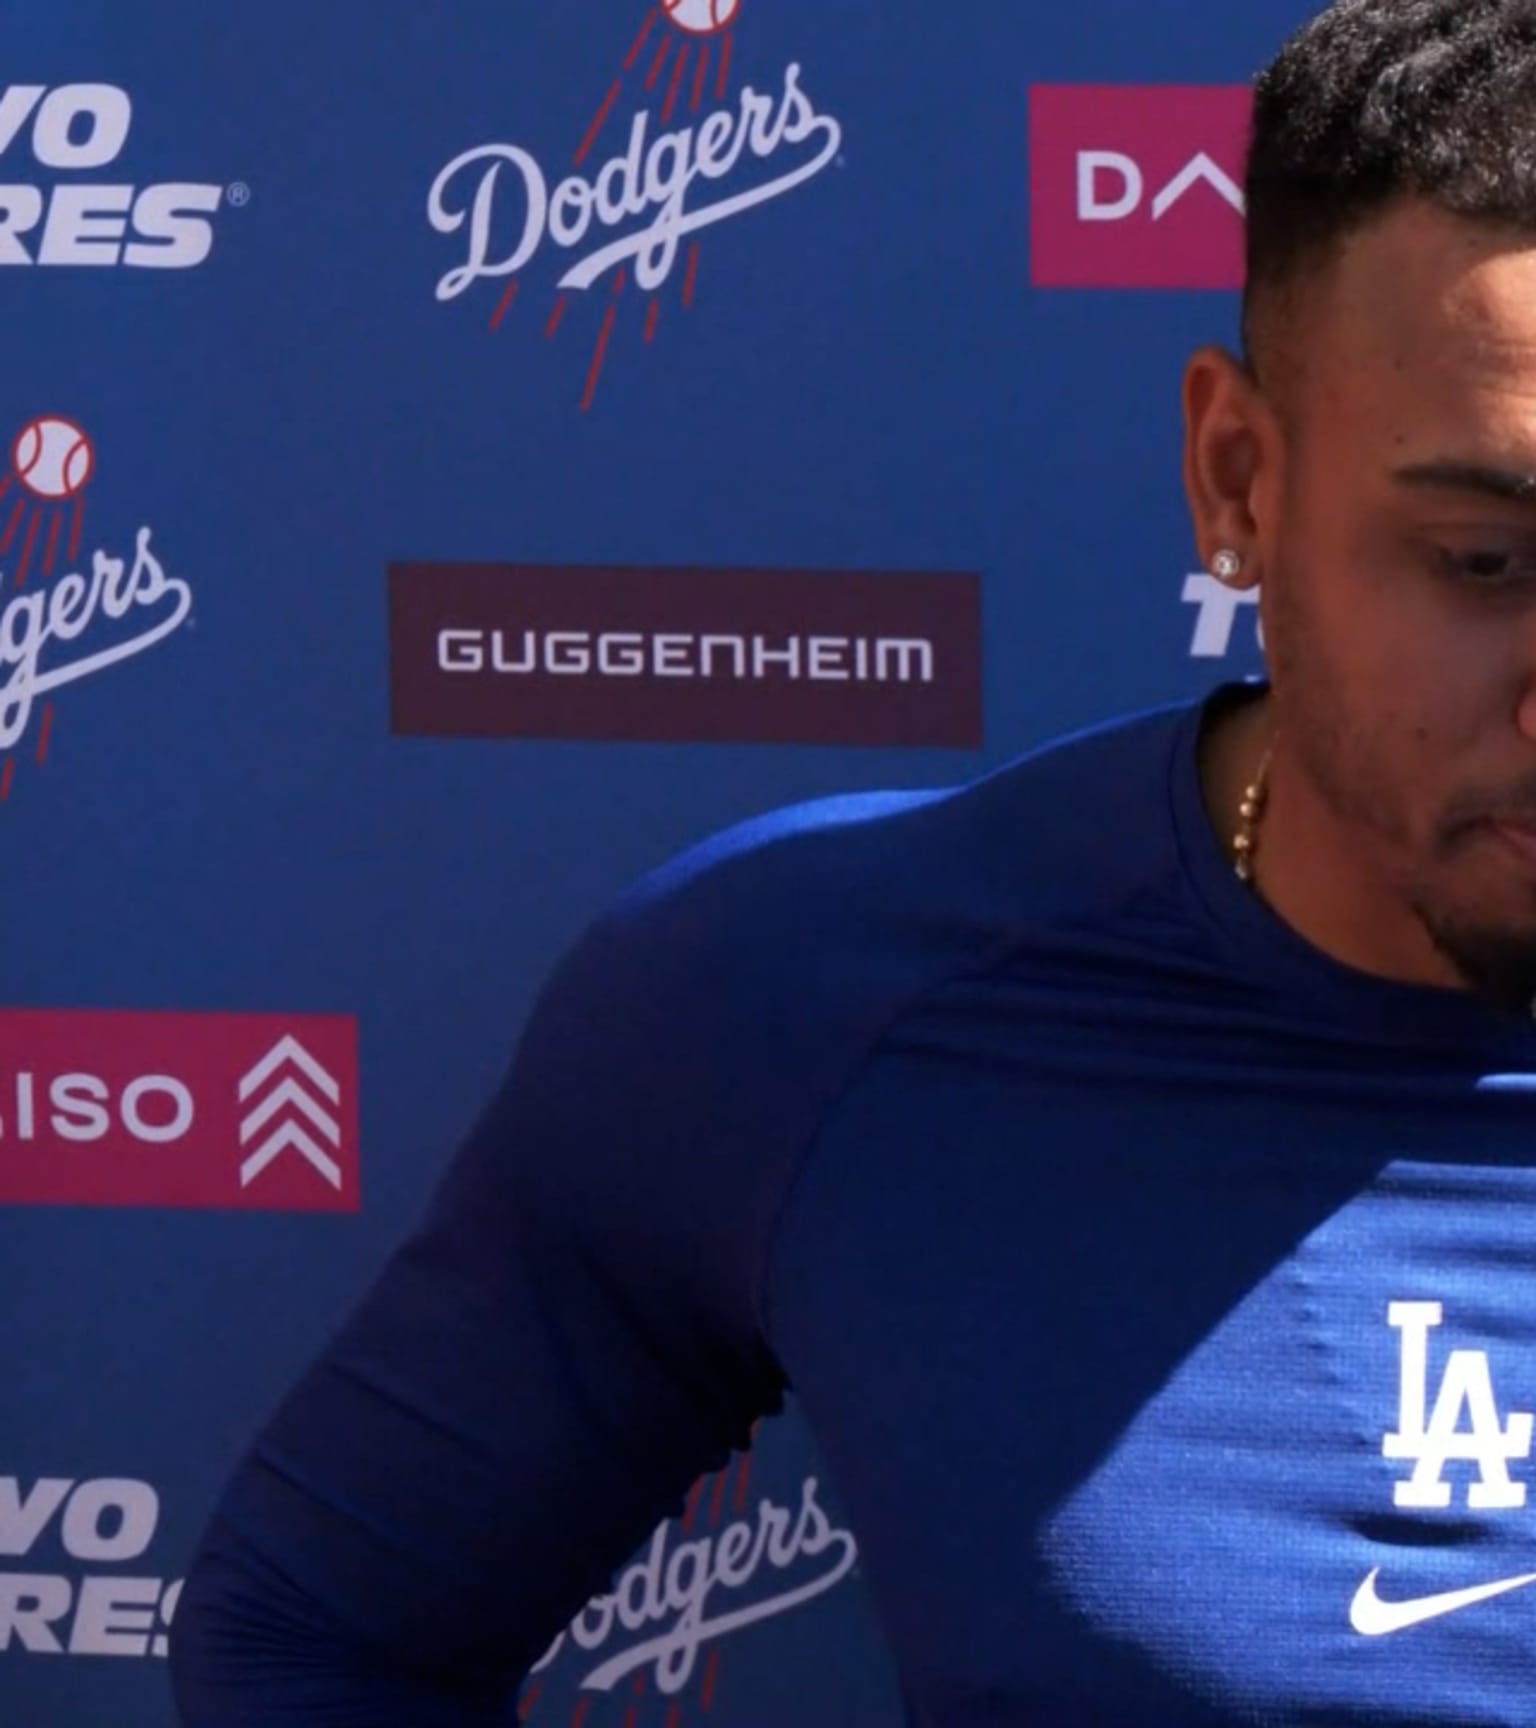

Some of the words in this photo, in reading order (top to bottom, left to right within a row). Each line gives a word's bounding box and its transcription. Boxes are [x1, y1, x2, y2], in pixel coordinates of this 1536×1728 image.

[427, 62, 841, 300] Dodgers
[0, 526, 191, 749] gers
[438, 629, 932, 681] GUGGENHEIM
[1181, 573, 1264, 656] T
[0, 1072, 194, 1142] ISO
[1382, 1301, 1534, 1509] LA
[530, 1476, 858, 1694] odgers
